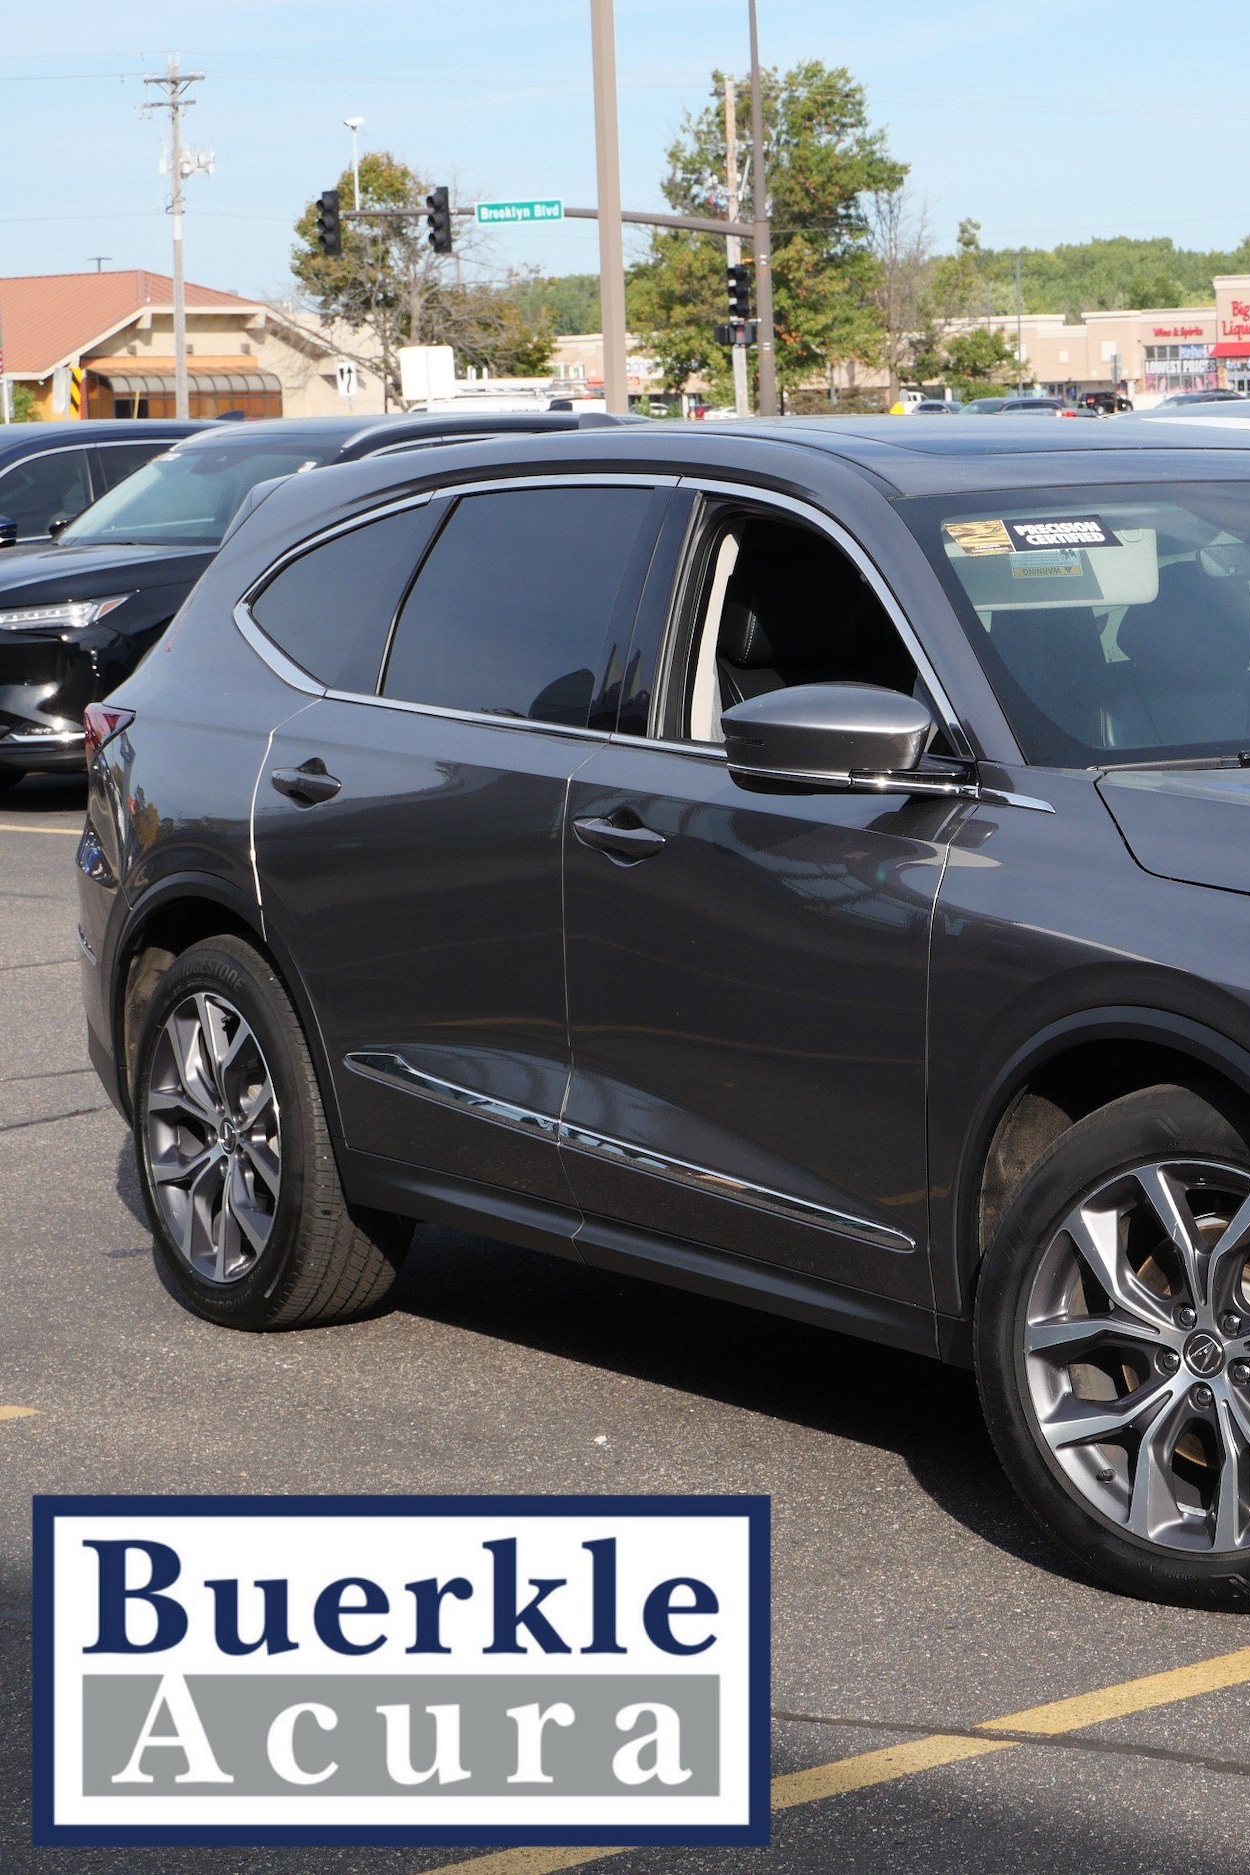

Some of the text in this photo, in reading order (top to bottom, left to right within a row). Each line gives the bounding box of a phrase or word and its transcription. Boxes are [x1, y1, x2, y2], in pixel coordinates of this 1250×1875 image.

[480, 203, 559, 220] Brooklyn Blvd
[1231, 301, 1250, 321] Big
[1153, 327, 1171, 337] Wine
[1145, 358, 1217, 374] LOWEST PRICES
[1013, 521, 1102, 536] PRECISION
[1025, 532, 1106, 545] CERTIFIED
[1022, 566, 1061, 576] WARNING
[170, 958, 246, 992] IDGESTONE
